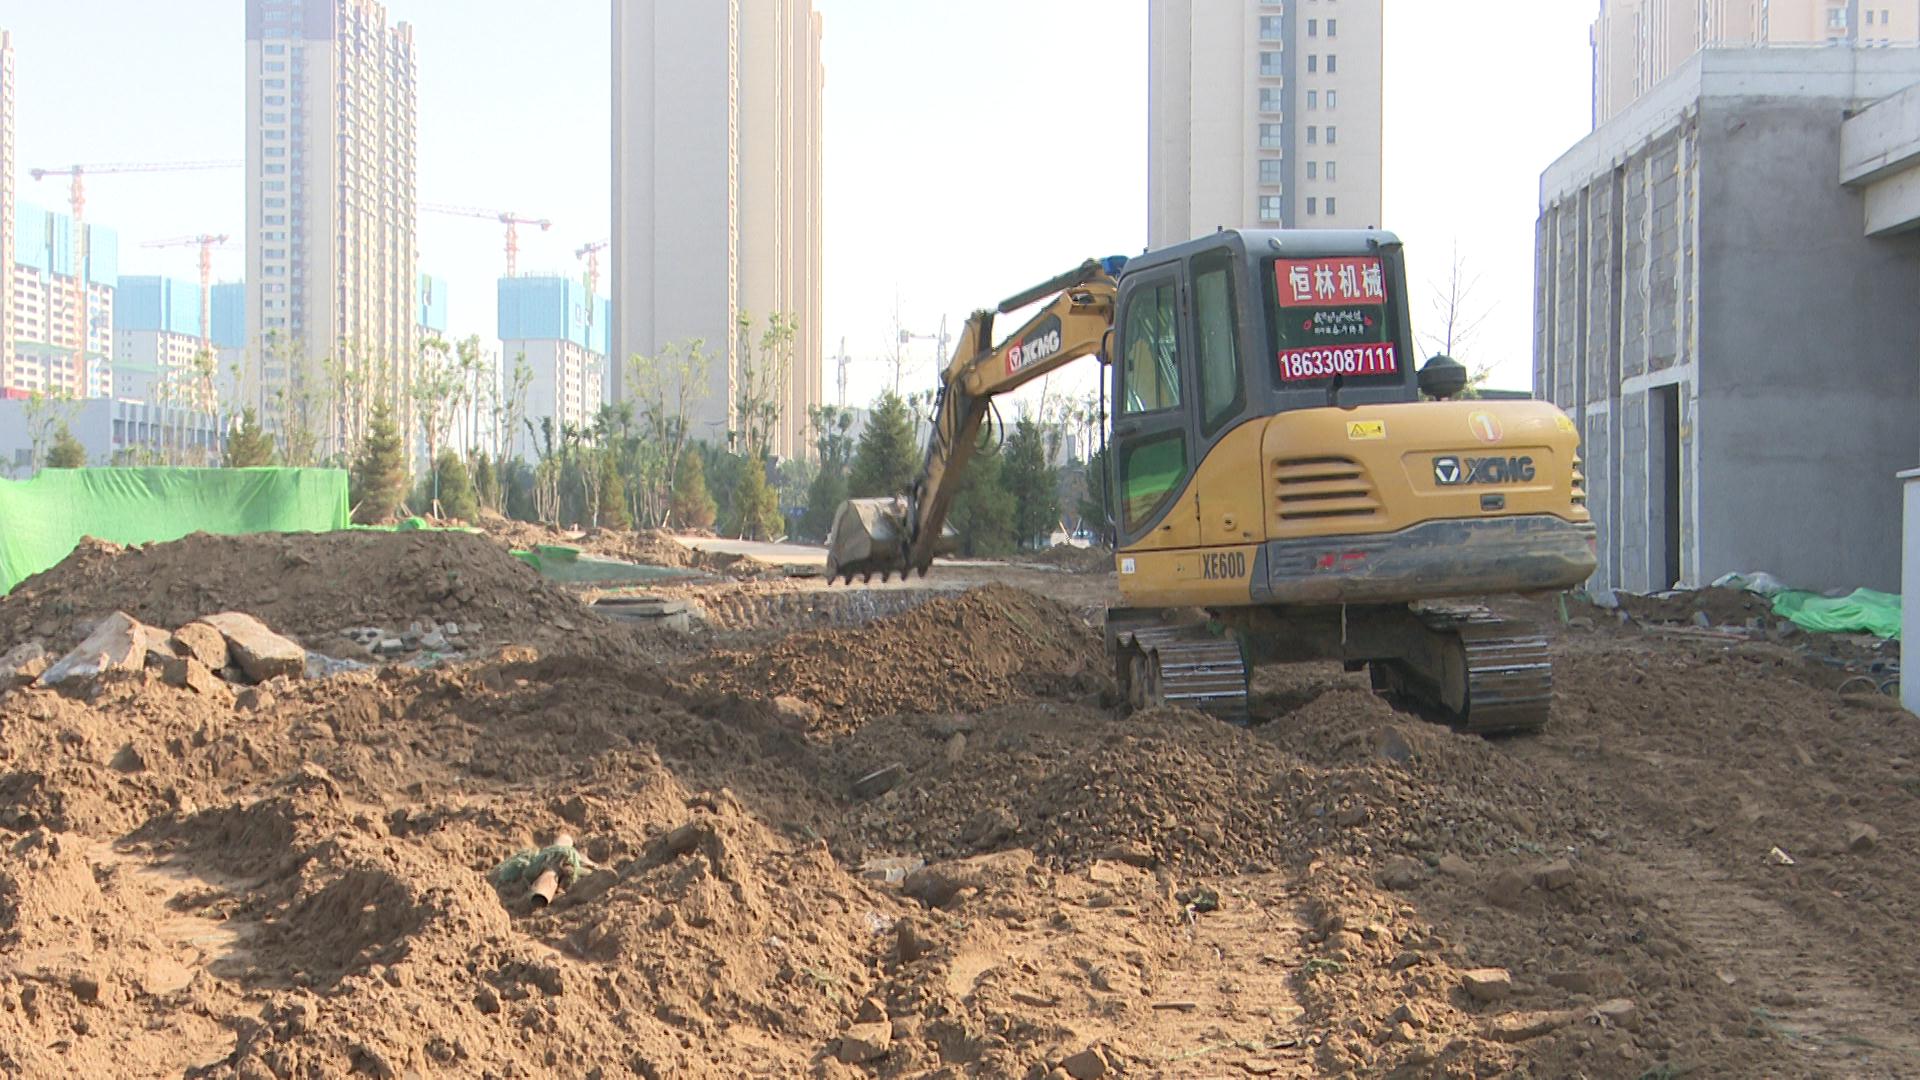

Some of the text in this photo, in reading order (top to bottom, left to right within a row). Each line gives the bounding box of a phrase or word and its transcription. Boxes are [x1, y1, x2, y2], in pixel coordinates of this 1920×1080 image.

[1289, 262, 1383, 301] 恒林机械
[1022, 330, 1060, 366] XCMG
[1281, 347, 1396, 378] 18633087111
[1475, 415, 1495, 441] 1
[1464, 456, 1536, 485] XCMG
[1202, 551, 1247, 580] XE60D
